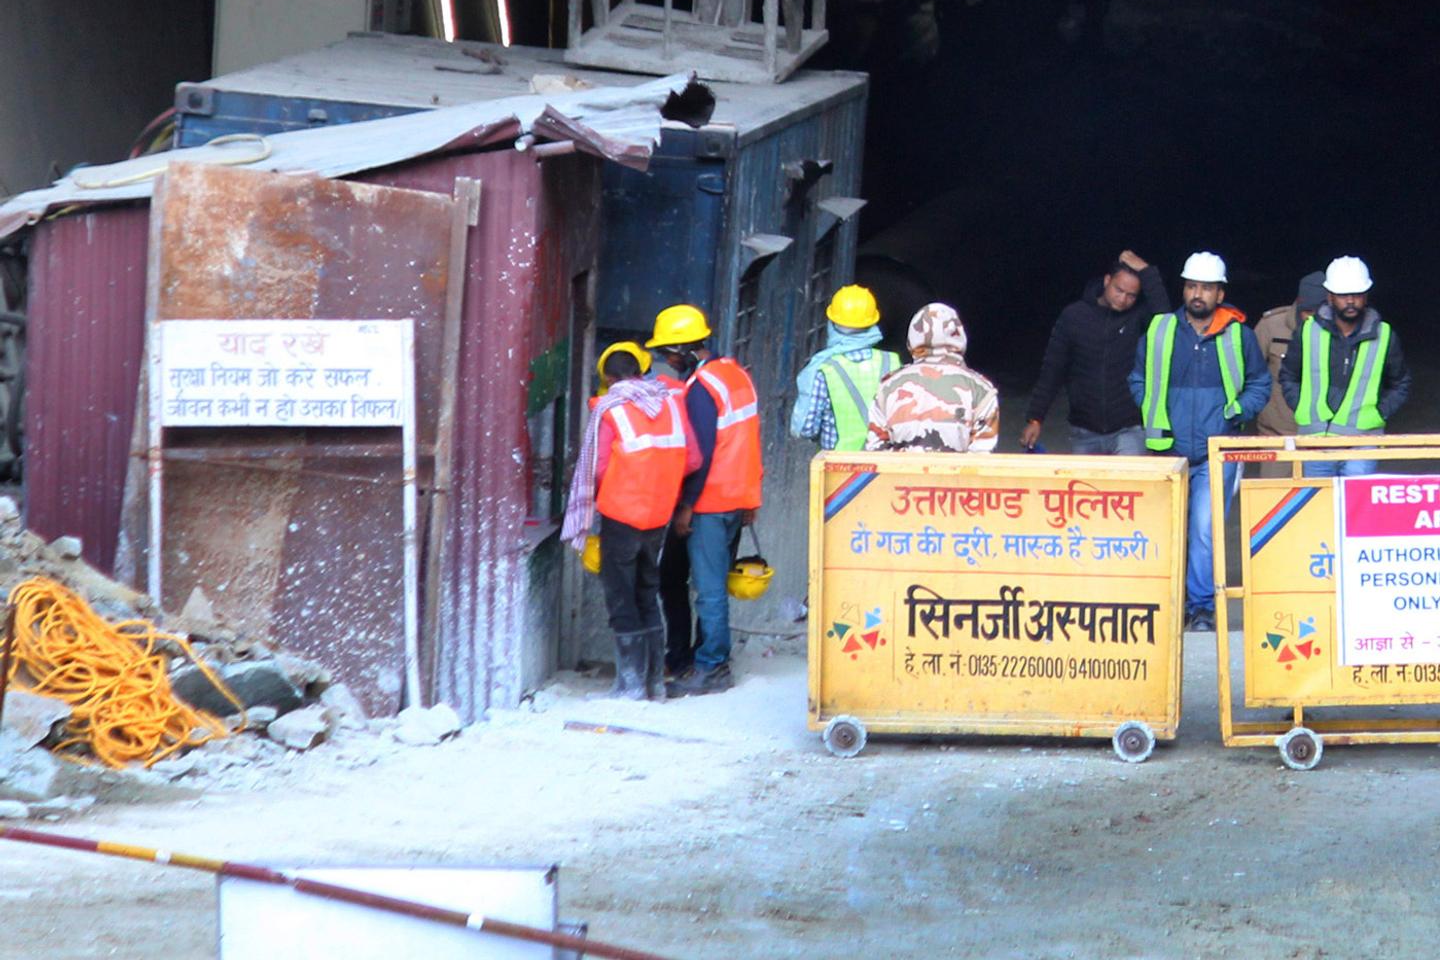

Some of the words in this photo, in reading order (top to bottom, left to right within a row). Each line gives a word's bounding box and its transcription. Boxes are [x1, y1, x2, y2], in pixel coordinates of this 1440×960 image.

[217, 333, 271, 355] याद
[210, 361, 252, 386] नियम
[257, 361, 280, 387] जो
[255, 399, 270, 417] न
[274, 393, 296, 421] हो
[891, 486, 1030, 518] उत्तराखण्ड
[1038, 479, 1144, 529] पुलिस
[850, 521, 872, 554] दो
[876, 531, 914, 555] गज
[916, 525, 946, 554] की
[1001, 534, 1063, 559] मास्क
[1067, 526, 1087, 563] है
[1309, 541, 1335, 578] दो
[904, 584, 1024, 641] सिनर्जी
[1024, 600, 1160, 645] अस्पताल
[1355, 637, 1393, 650] आज्ञा
[1400, 632, 1415, 650] से
